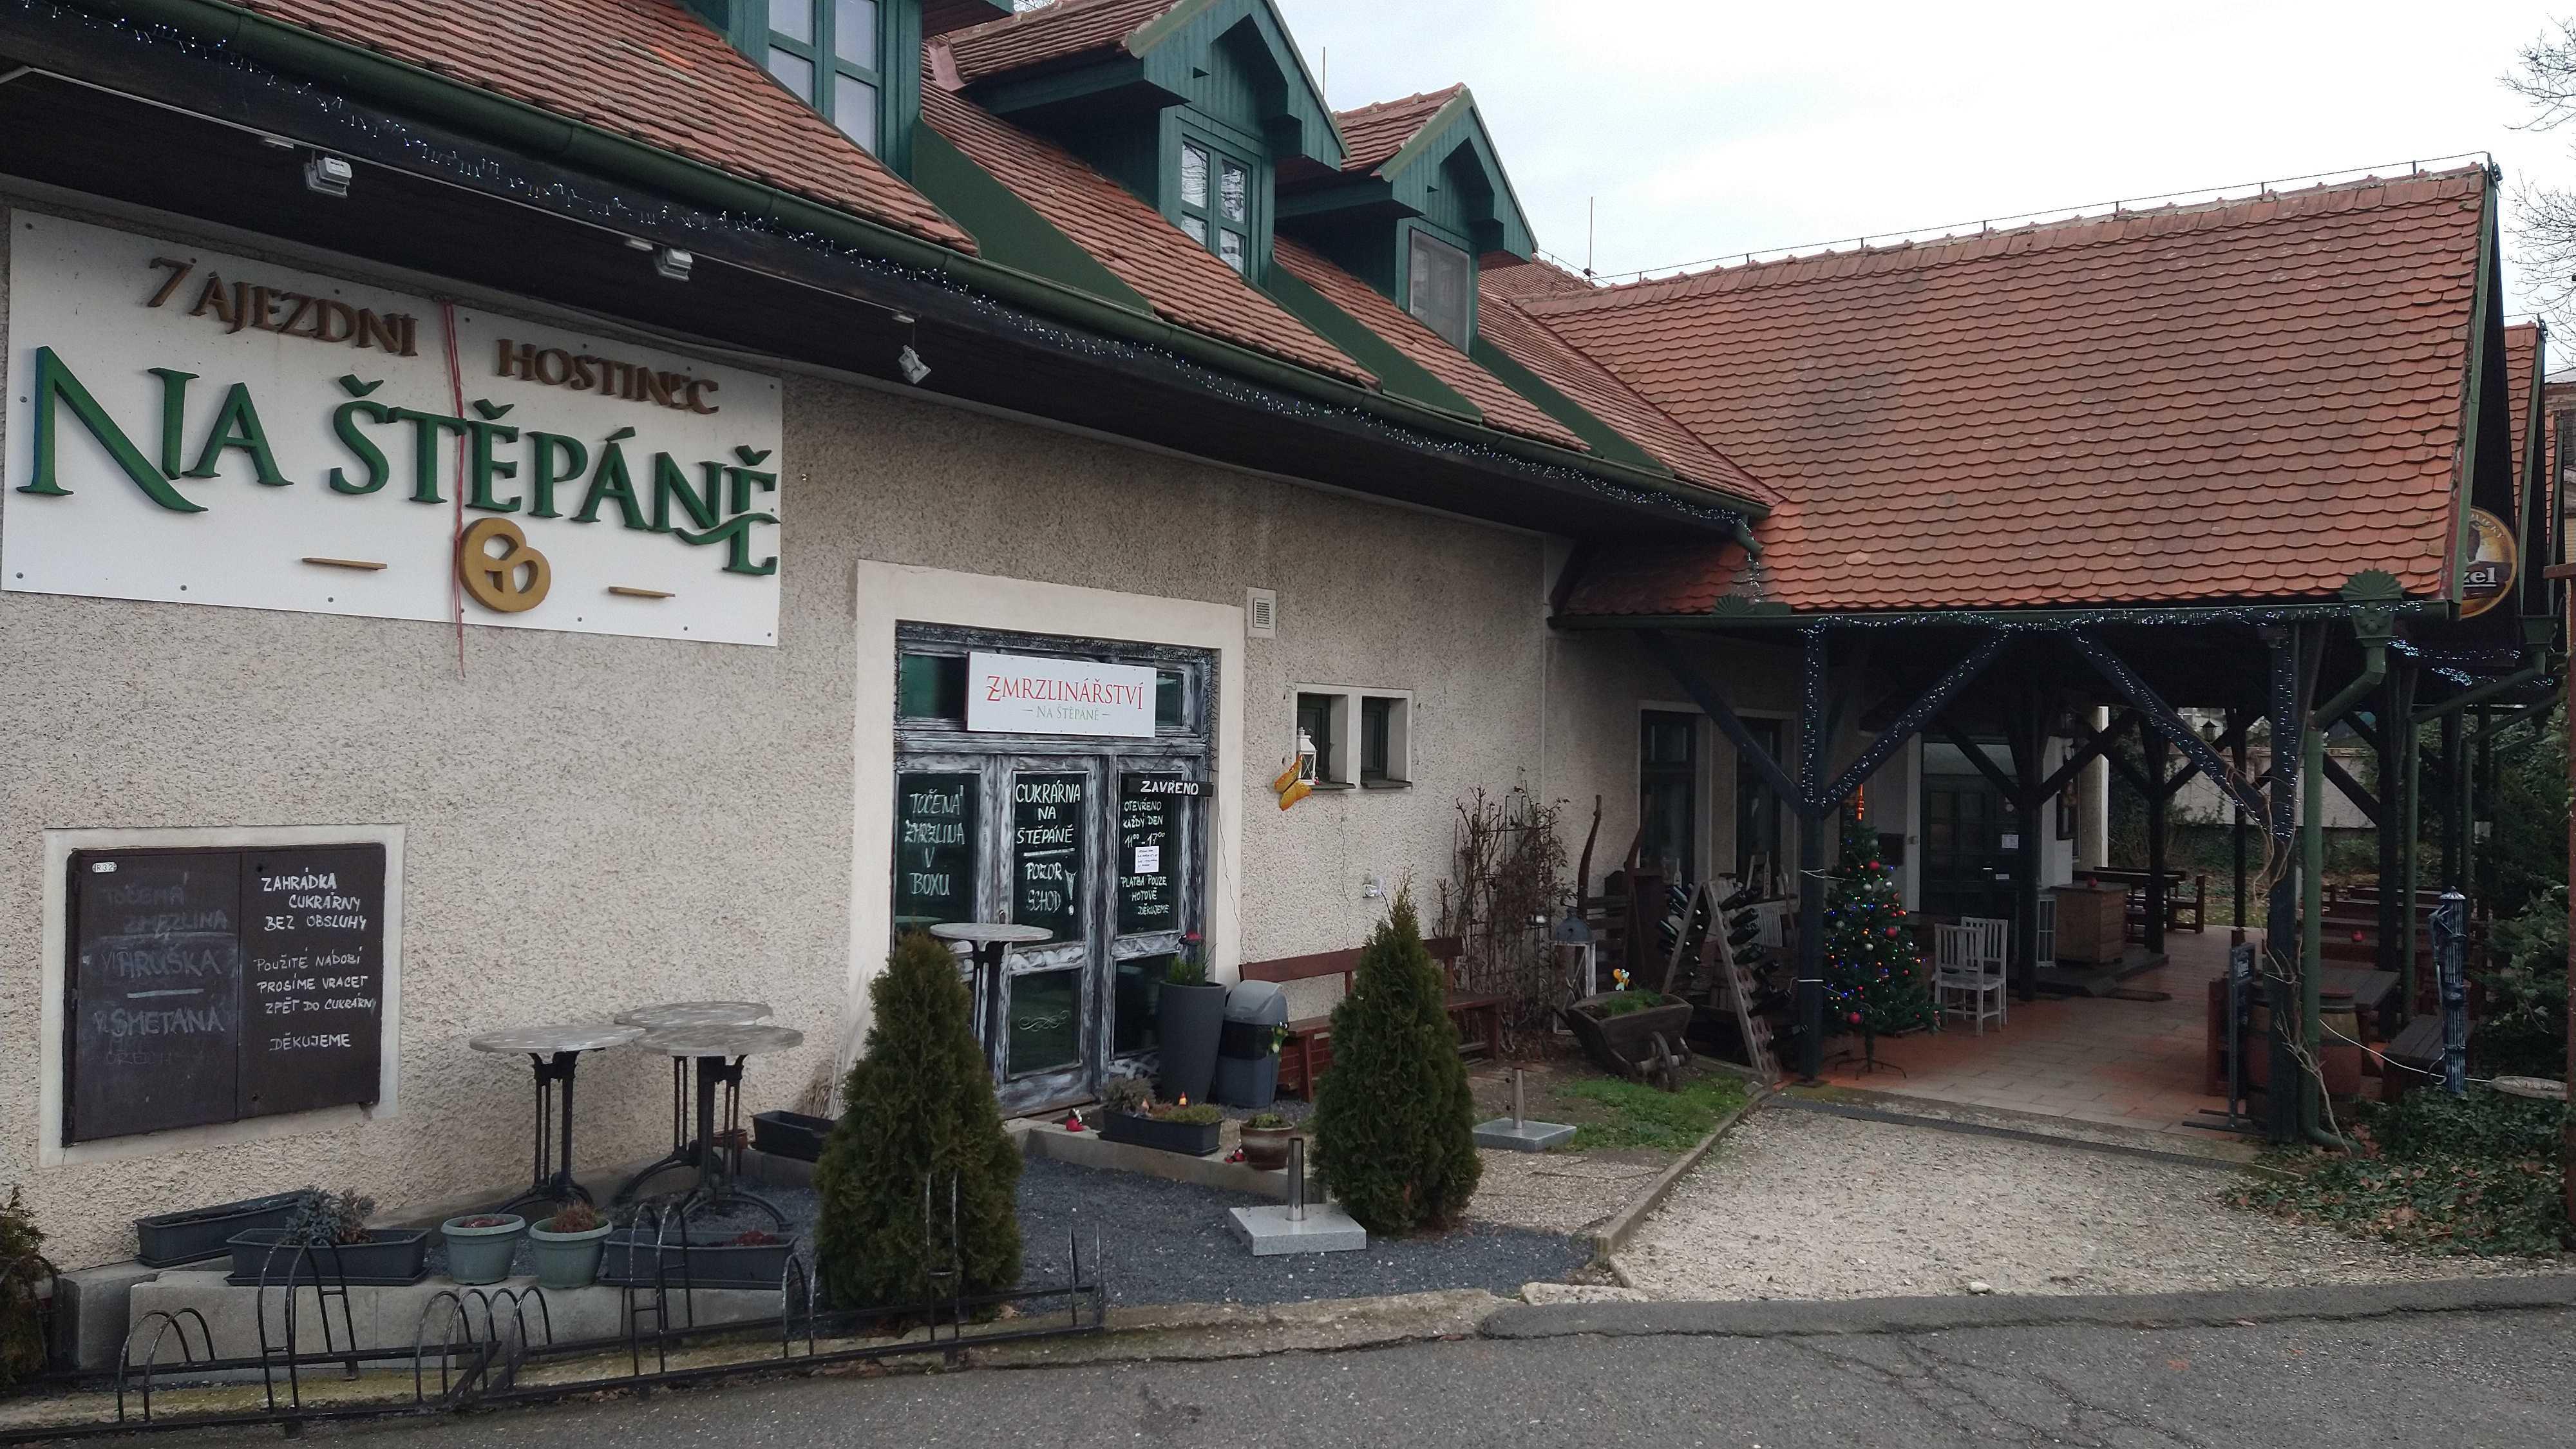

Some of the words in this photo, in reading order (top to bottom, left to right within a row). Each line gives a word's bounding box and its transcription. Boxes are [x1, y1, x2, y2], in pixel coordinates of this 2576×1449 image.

[496, 338, 720, 415] HOSTINEC
[16, 345, 294, 514] NA
[328, 374, 780, 576] ŠTĚPÁNĚ
[986, 675, 1144, 710] ZMRZLINÁŘSTVÍ
[1037, 705, 1052, 719] NA
[1016, 780, 1081, 804] CUKRÁRNA
[1140, 780, 1198, 795] ZAVŘENO
[909, 784, 964, 815] TOČENÁ
[1124, 797, 1162, 811] OTEVŘENO
[1037, 806, 1056, 821] NA
[1147, 815, 1163, 826] DEN
[1016, 824, 1074, 844] ŠTĚPÁNĚ
[924, 847, 936, 868] V
[261, 867, 337, 892] ZAHRÁDKA
[1025, 861, 1063, 880] POZOR
[909, 872, 951, 896] BOXU
[1148, 875, 1168, 887] POUZE
[289, 891, 361, 912] CUKRÁRNY
[1026, 889, 1061, 913] SCHOD
[264, 915, 296, 931] BEZ
[306, 914, 367, 931] OBSLUHY
[258, 973, 316, 994] PROSÍME
[322, 975, 368, 990] VRACET
[265, 997, 300, 1014] ZPĚT
[303, 1001, 320, 1011] DO
[269, 1032, 352, 1052] DĚKUJEME
